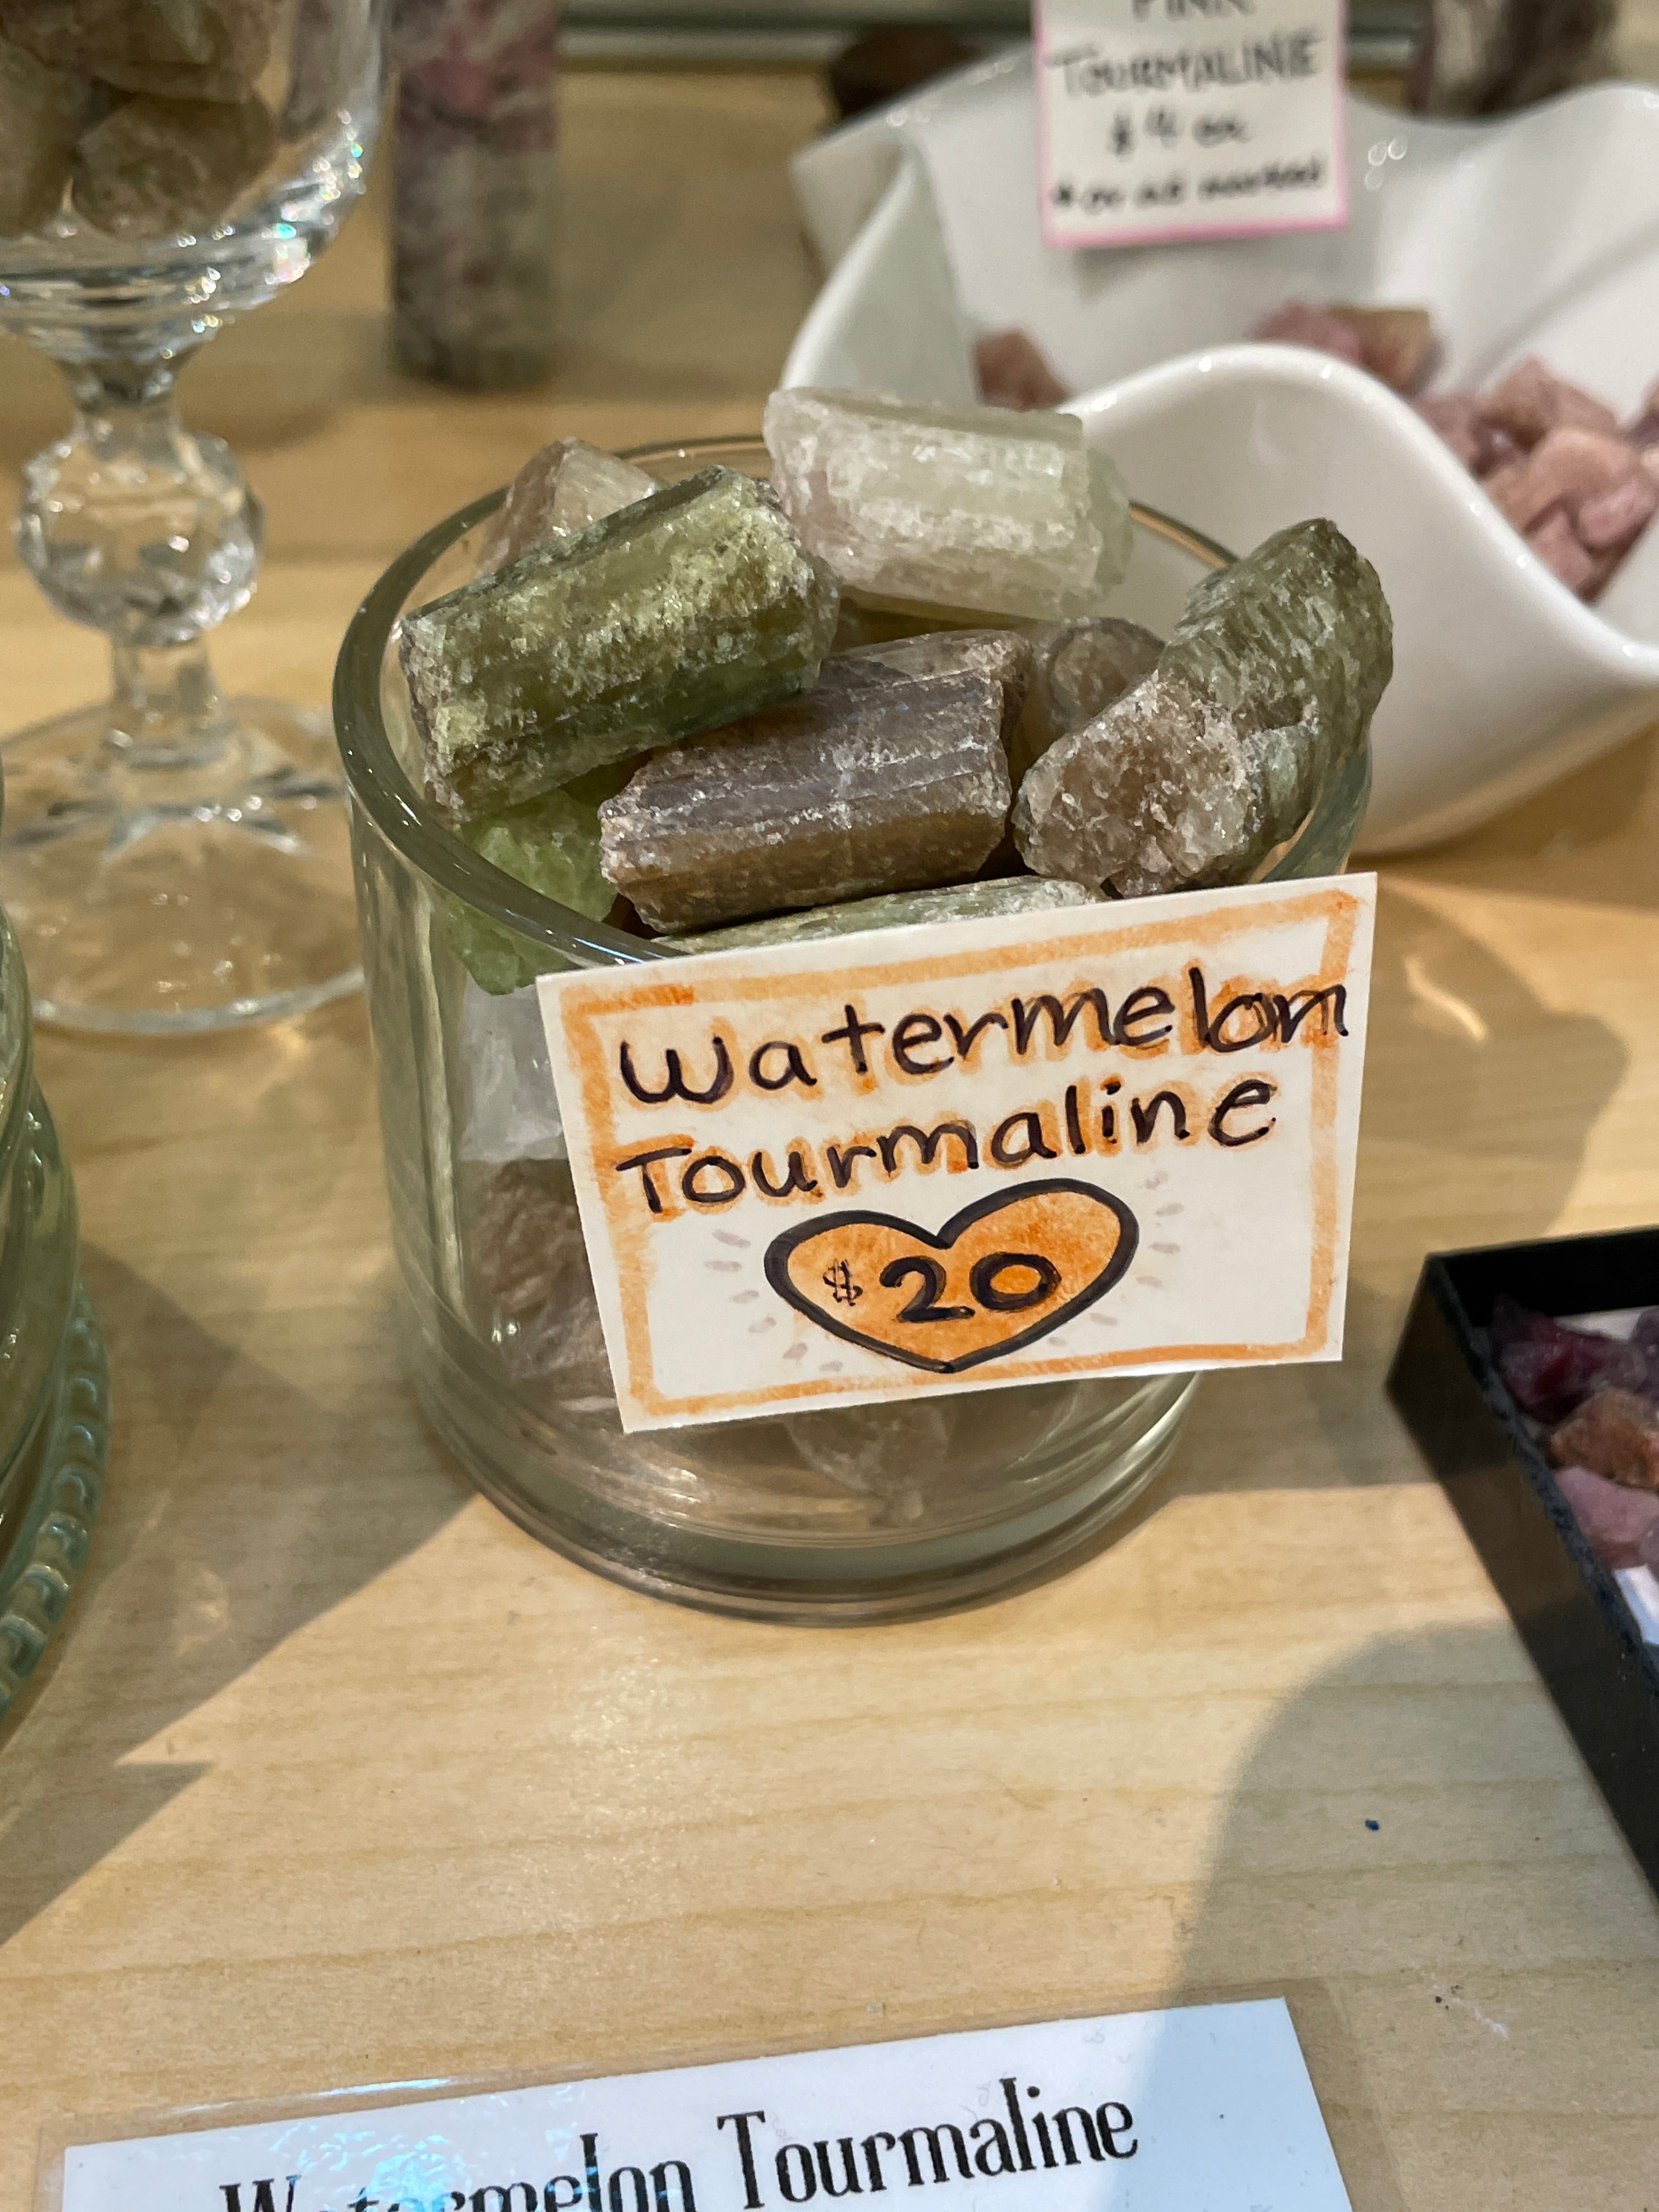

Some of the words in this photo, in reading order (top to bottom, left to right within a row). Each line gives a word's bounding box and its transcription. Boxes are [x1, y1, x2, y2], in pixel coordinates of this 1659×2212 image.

[1045, 30, 1323, 95] TOURMALINE
[620, 967, 1348, 1104] Watermelon
[616, 1079, 1278, 1214] Tourmaline
[822, 1251, 1063, 1323] $20
[219, 2132, 697, 2212] melon
[717, 2077, 1138, 2209] Tourmaline
